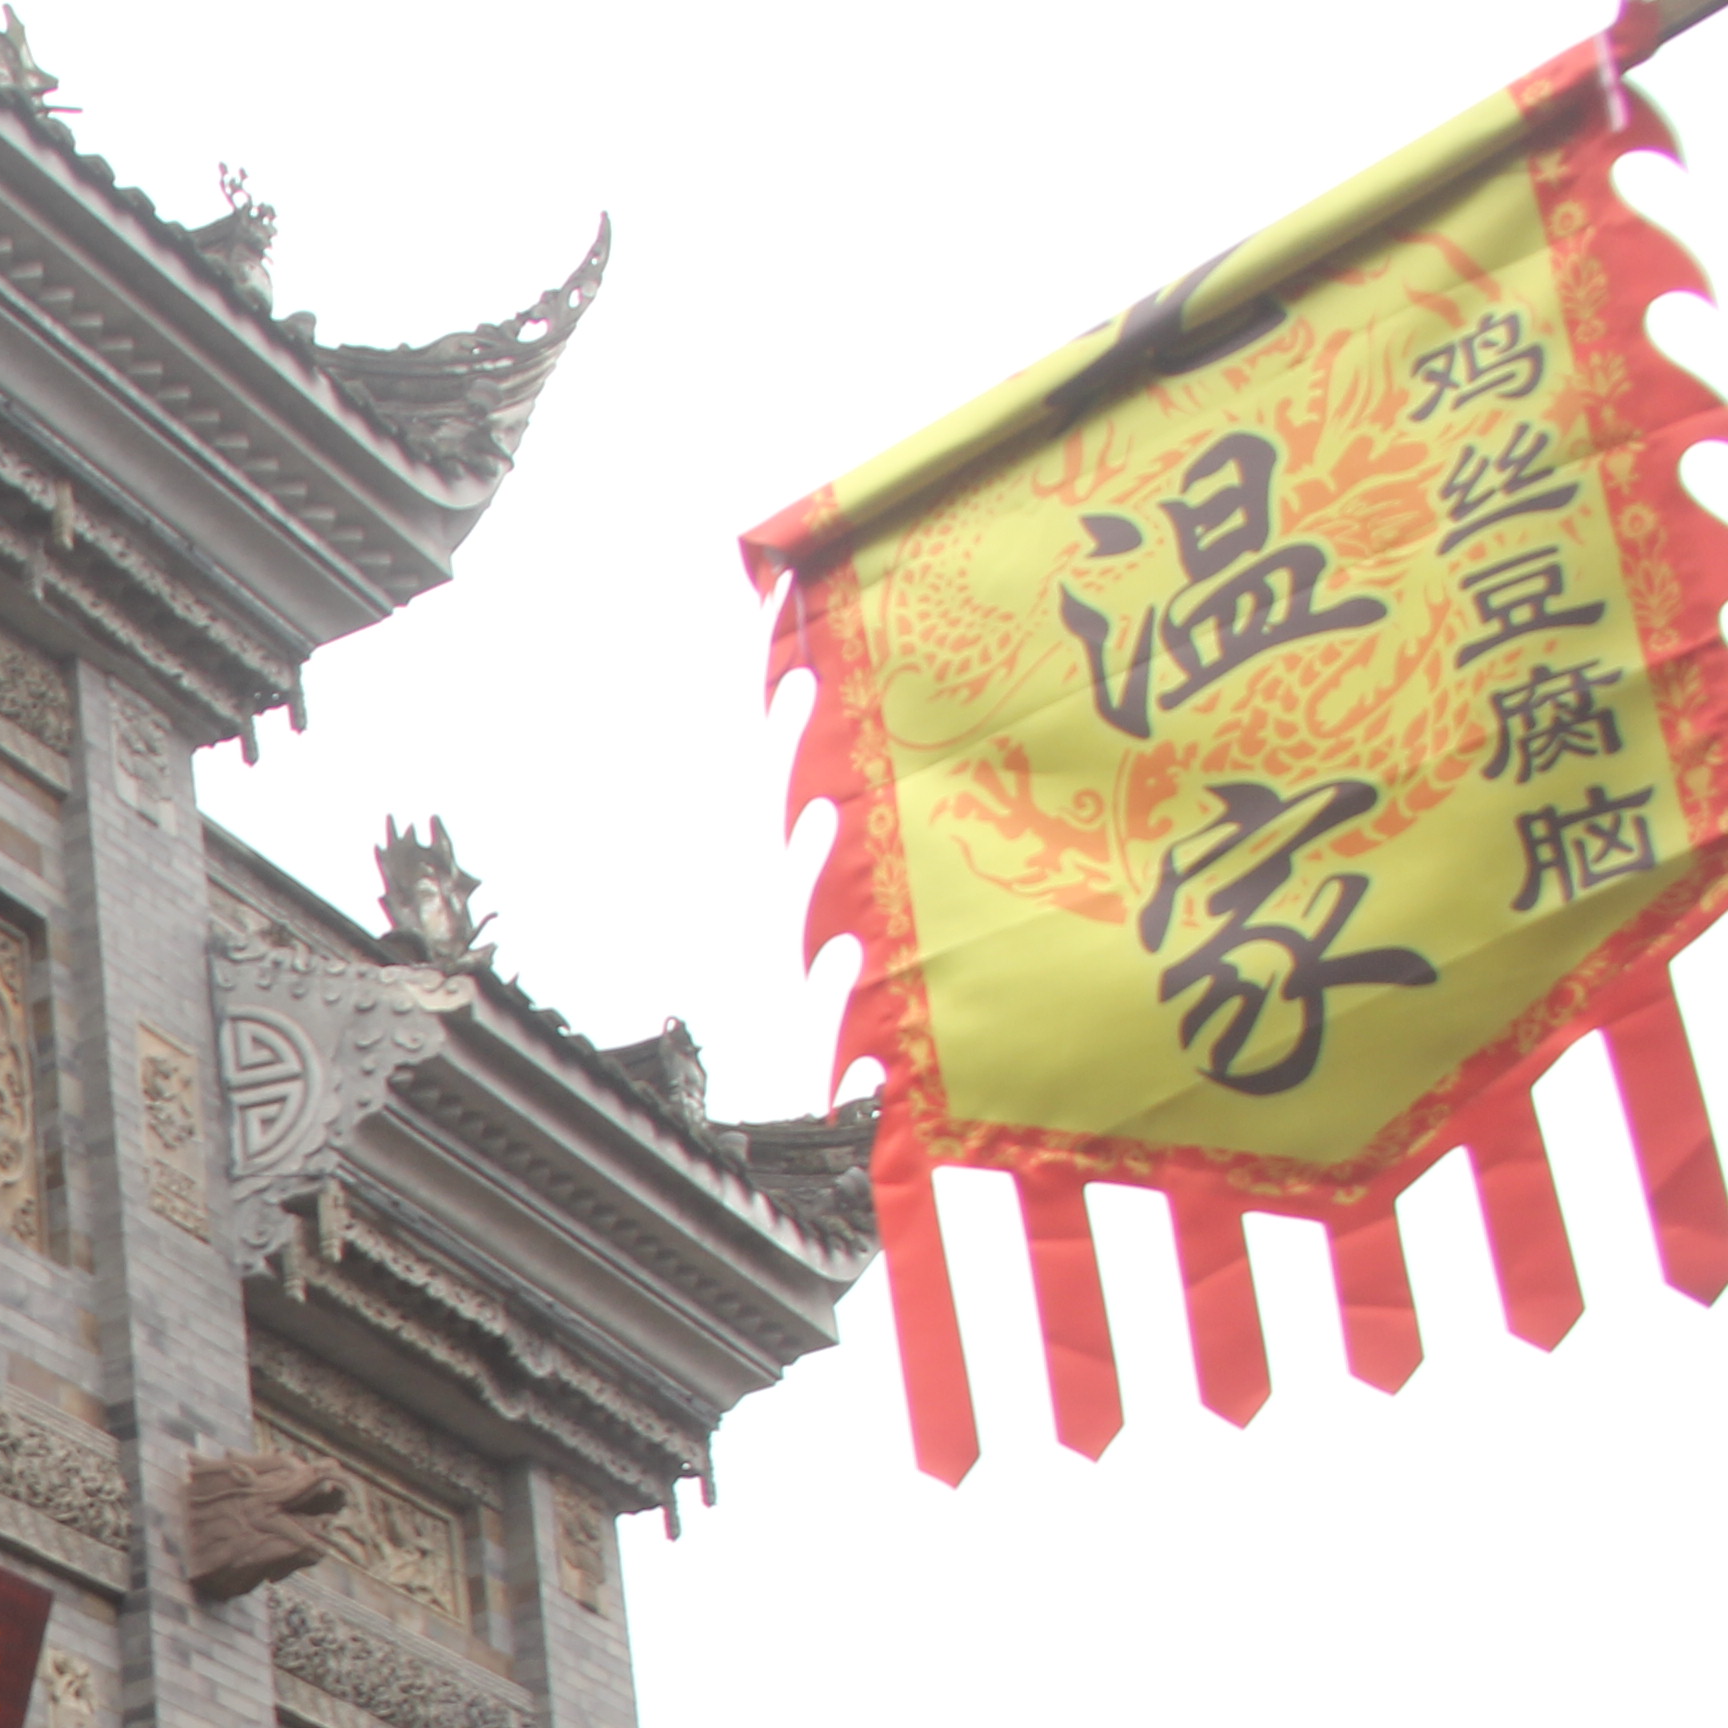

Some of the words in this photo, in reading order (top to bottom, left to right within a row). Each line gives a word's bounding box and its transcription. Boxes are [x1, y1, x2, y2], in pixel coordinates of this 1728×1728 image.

[1407, 311, 1657, 914] 鸡丝豆腐脑
